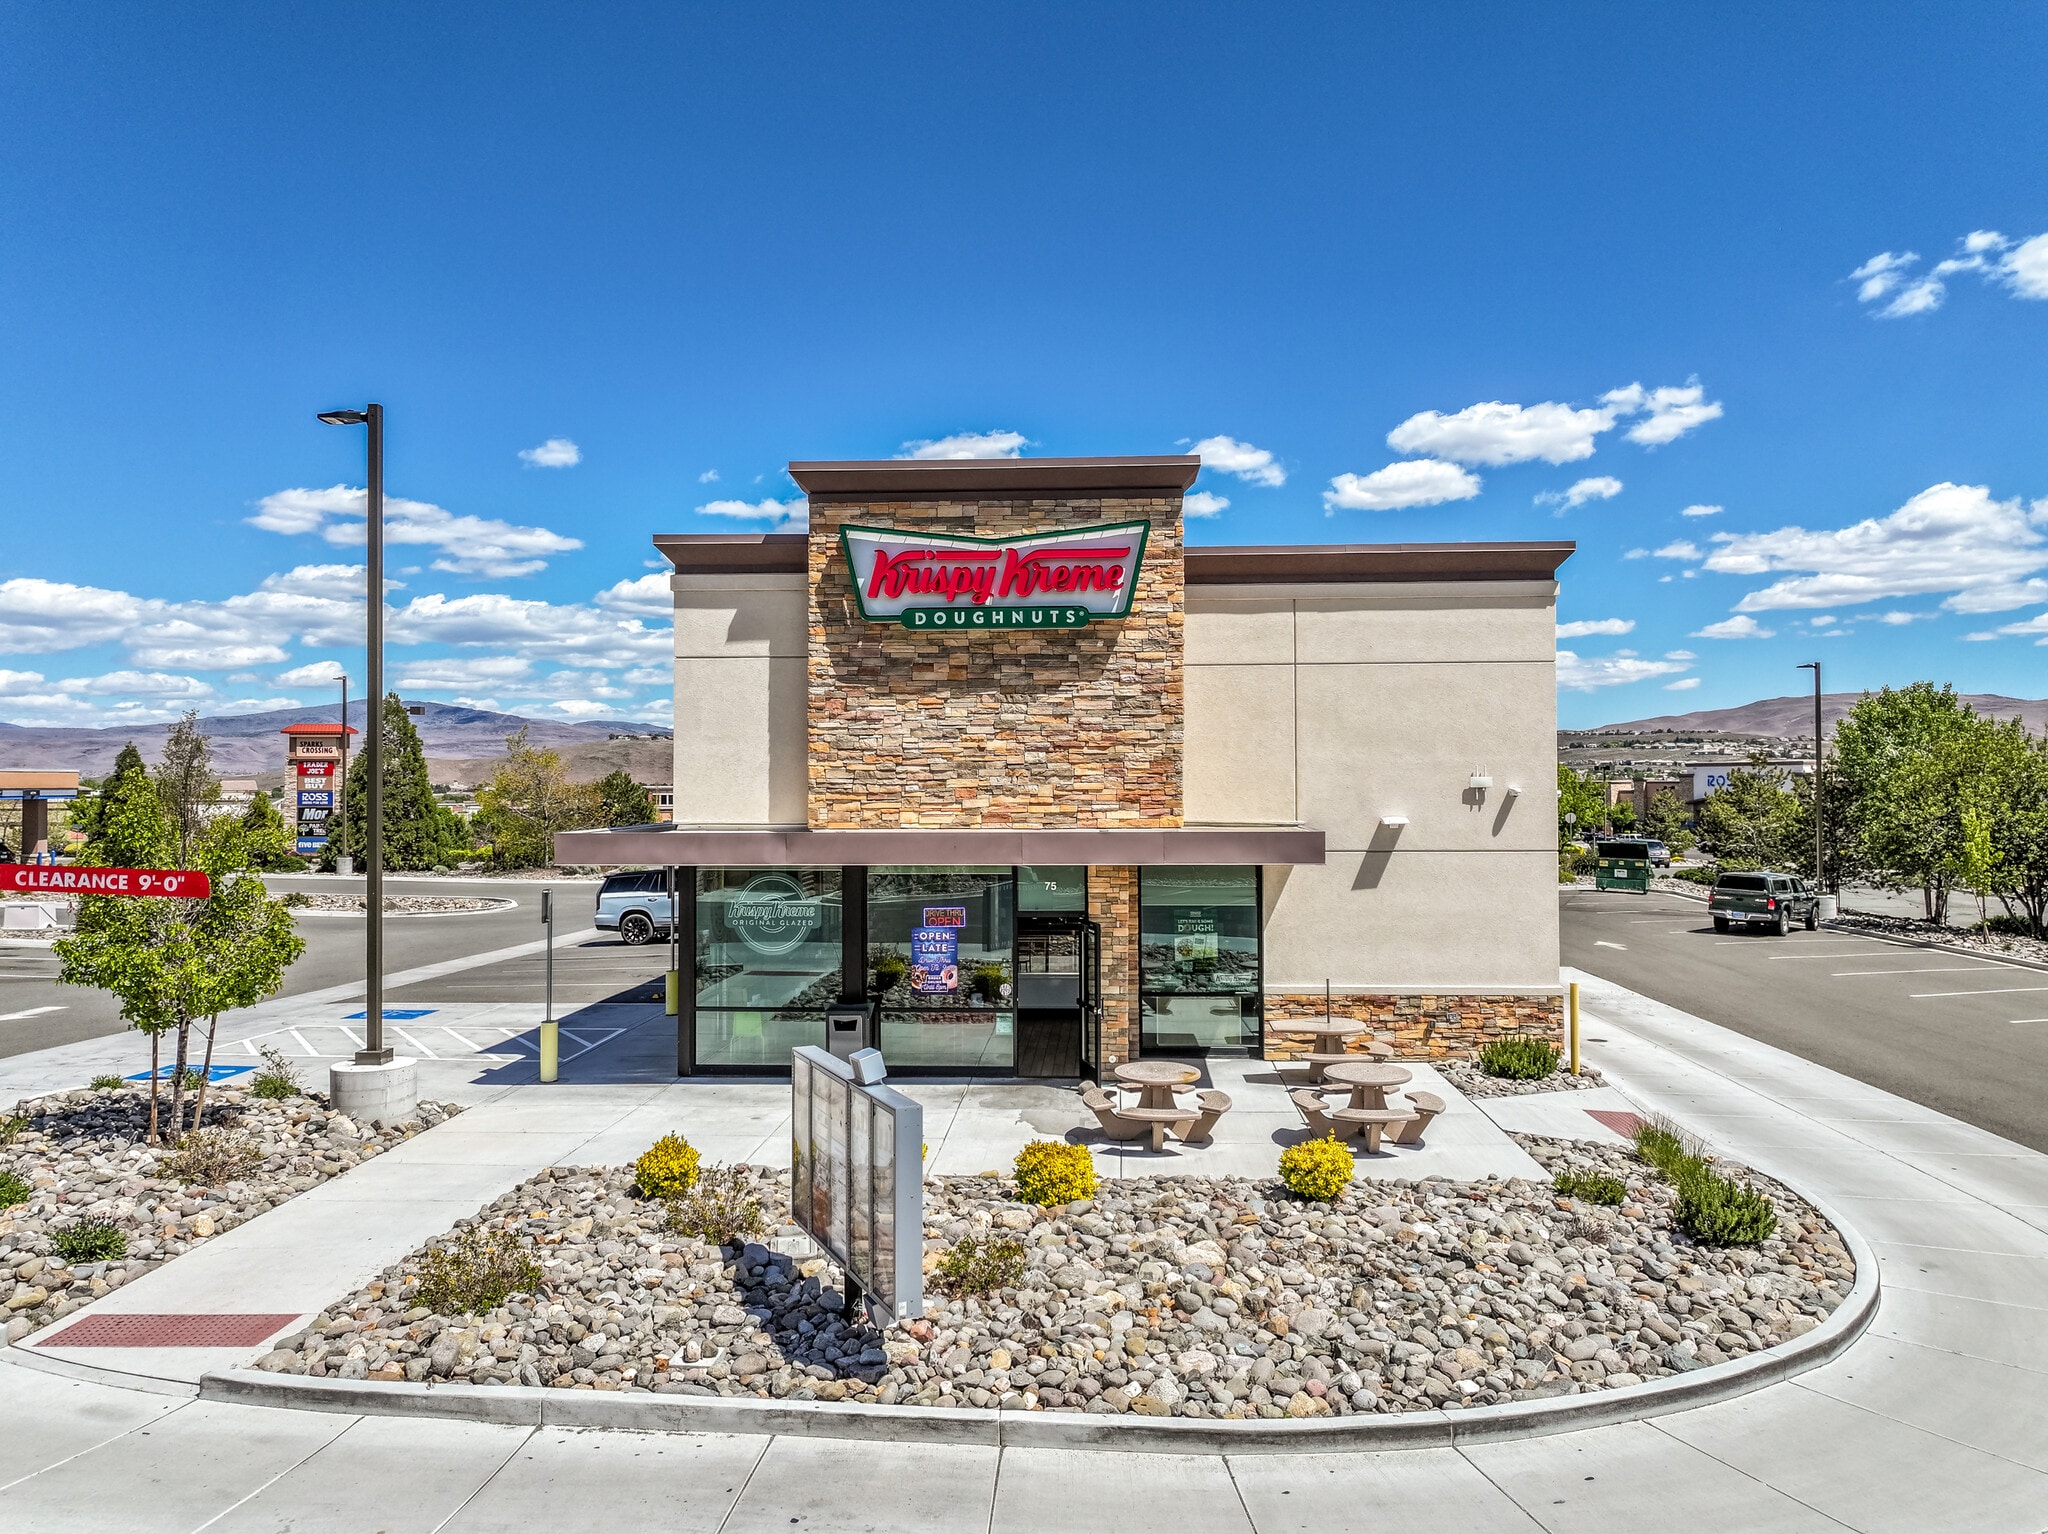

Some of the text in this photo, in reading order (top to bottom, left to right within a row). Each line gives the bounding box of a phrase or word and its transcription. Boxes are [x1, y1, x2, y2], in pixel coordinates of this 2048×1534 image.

[867, 548, 1131, 606] Krispy Kreme
[302, 793, 328, 801] ROSS
[15, 870, 185, 892] CLEARANCE 9'-0"
[1044, 881, 1057, 891] 75
[728, 900, 774, 920] Krispy
[946, 909, 964, 917] THRU
[928, 917, 961, 926] OPEN
[919, 932, 950, 940] OPEN
[922, 943, 948, 952] LATE
